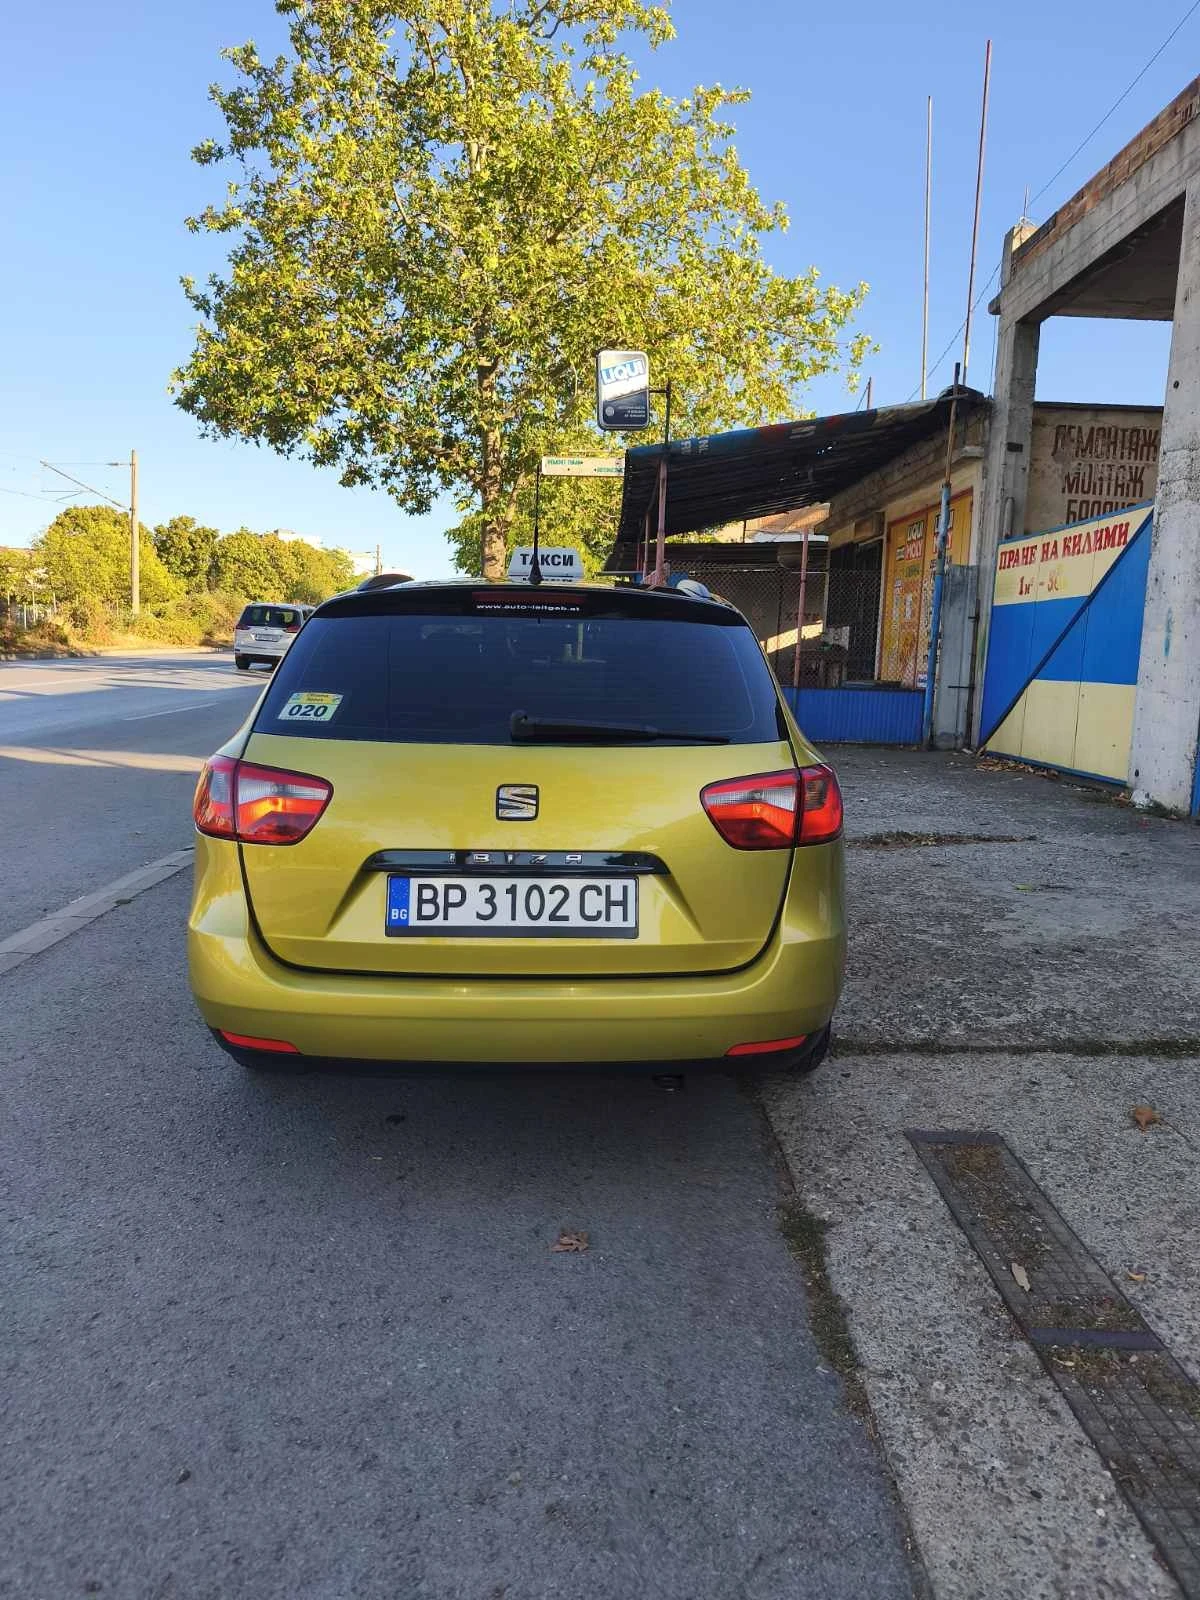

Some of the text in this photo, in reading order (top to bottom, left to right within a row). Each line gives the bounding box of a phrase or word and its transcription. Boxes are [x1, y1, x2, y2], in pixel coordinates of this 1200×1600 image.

[1061, 463, 1145, 498] МОНТАЖ
[998, 522, 1130, 571] ПРАНЕ НА КИЛИМИ
[288, 704, 328, 717] 020
[448, 852, 583, 865] IBIZA
[391, 908, 407, 920] BG
[416, 884, 629, 921] BP 3102 CH
